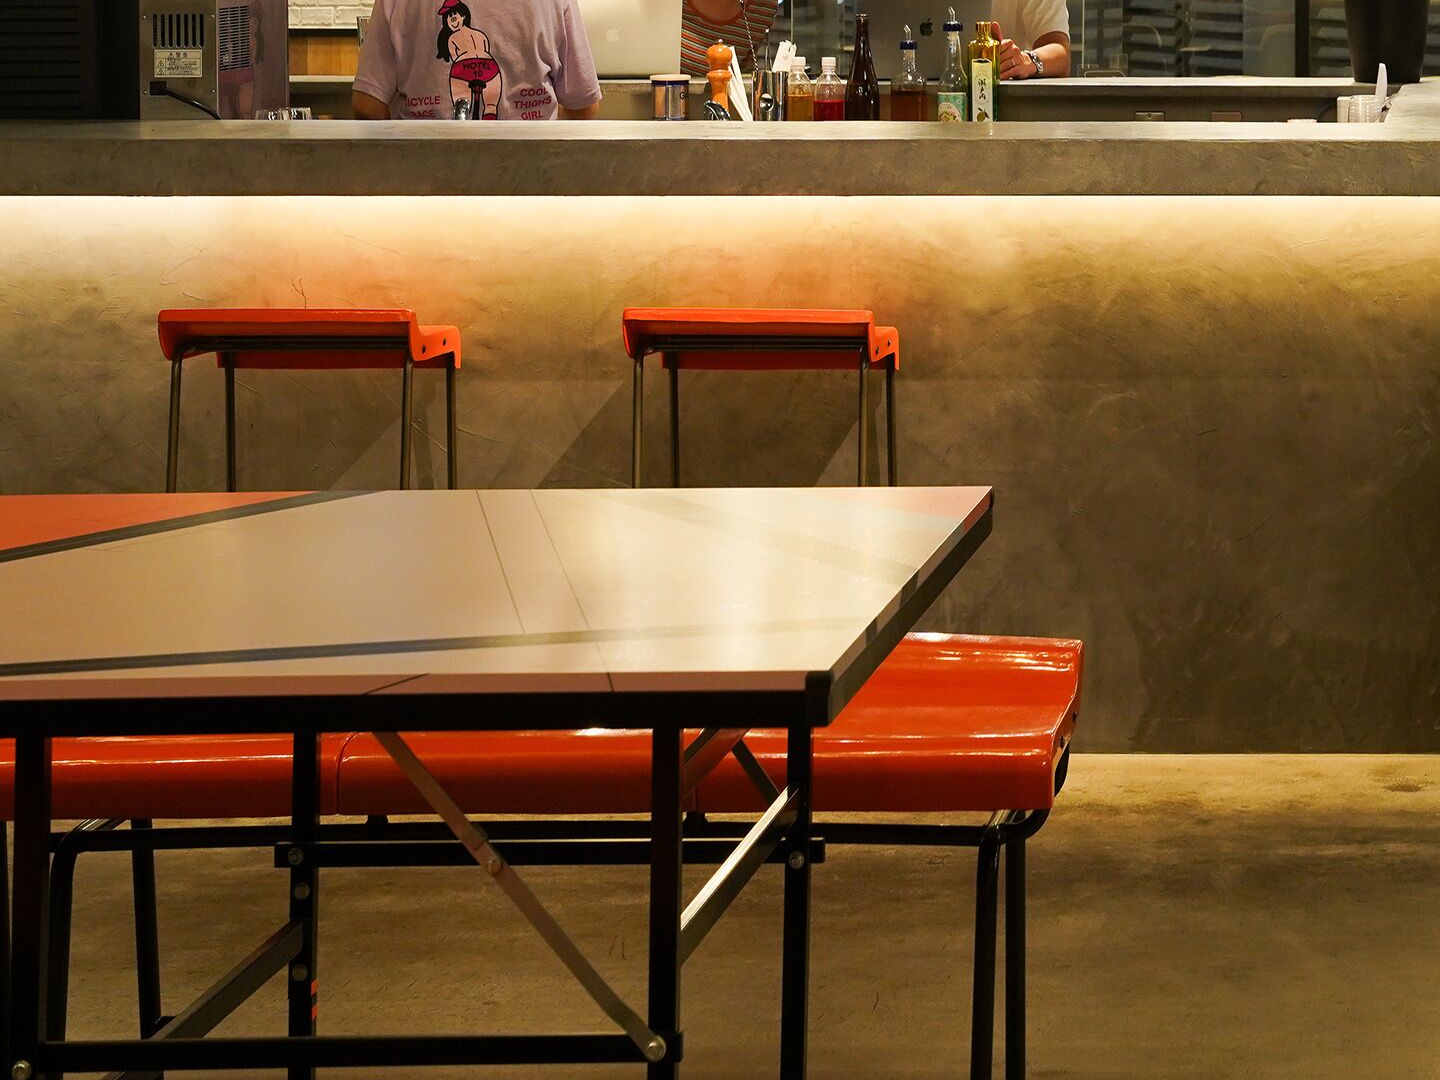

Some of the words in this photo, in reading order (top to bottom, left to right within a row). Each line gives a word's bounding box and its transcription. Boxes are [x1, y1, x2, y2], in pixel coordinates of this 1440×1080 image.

[463, 62, 490, 70] HOTEL
[520, 87, 548, 97] COOL
[406, 96, 440, 107] ICYCLE
[513, 97, 551, 109] THIGHS
[521, 110, 543, 120] GIRL
